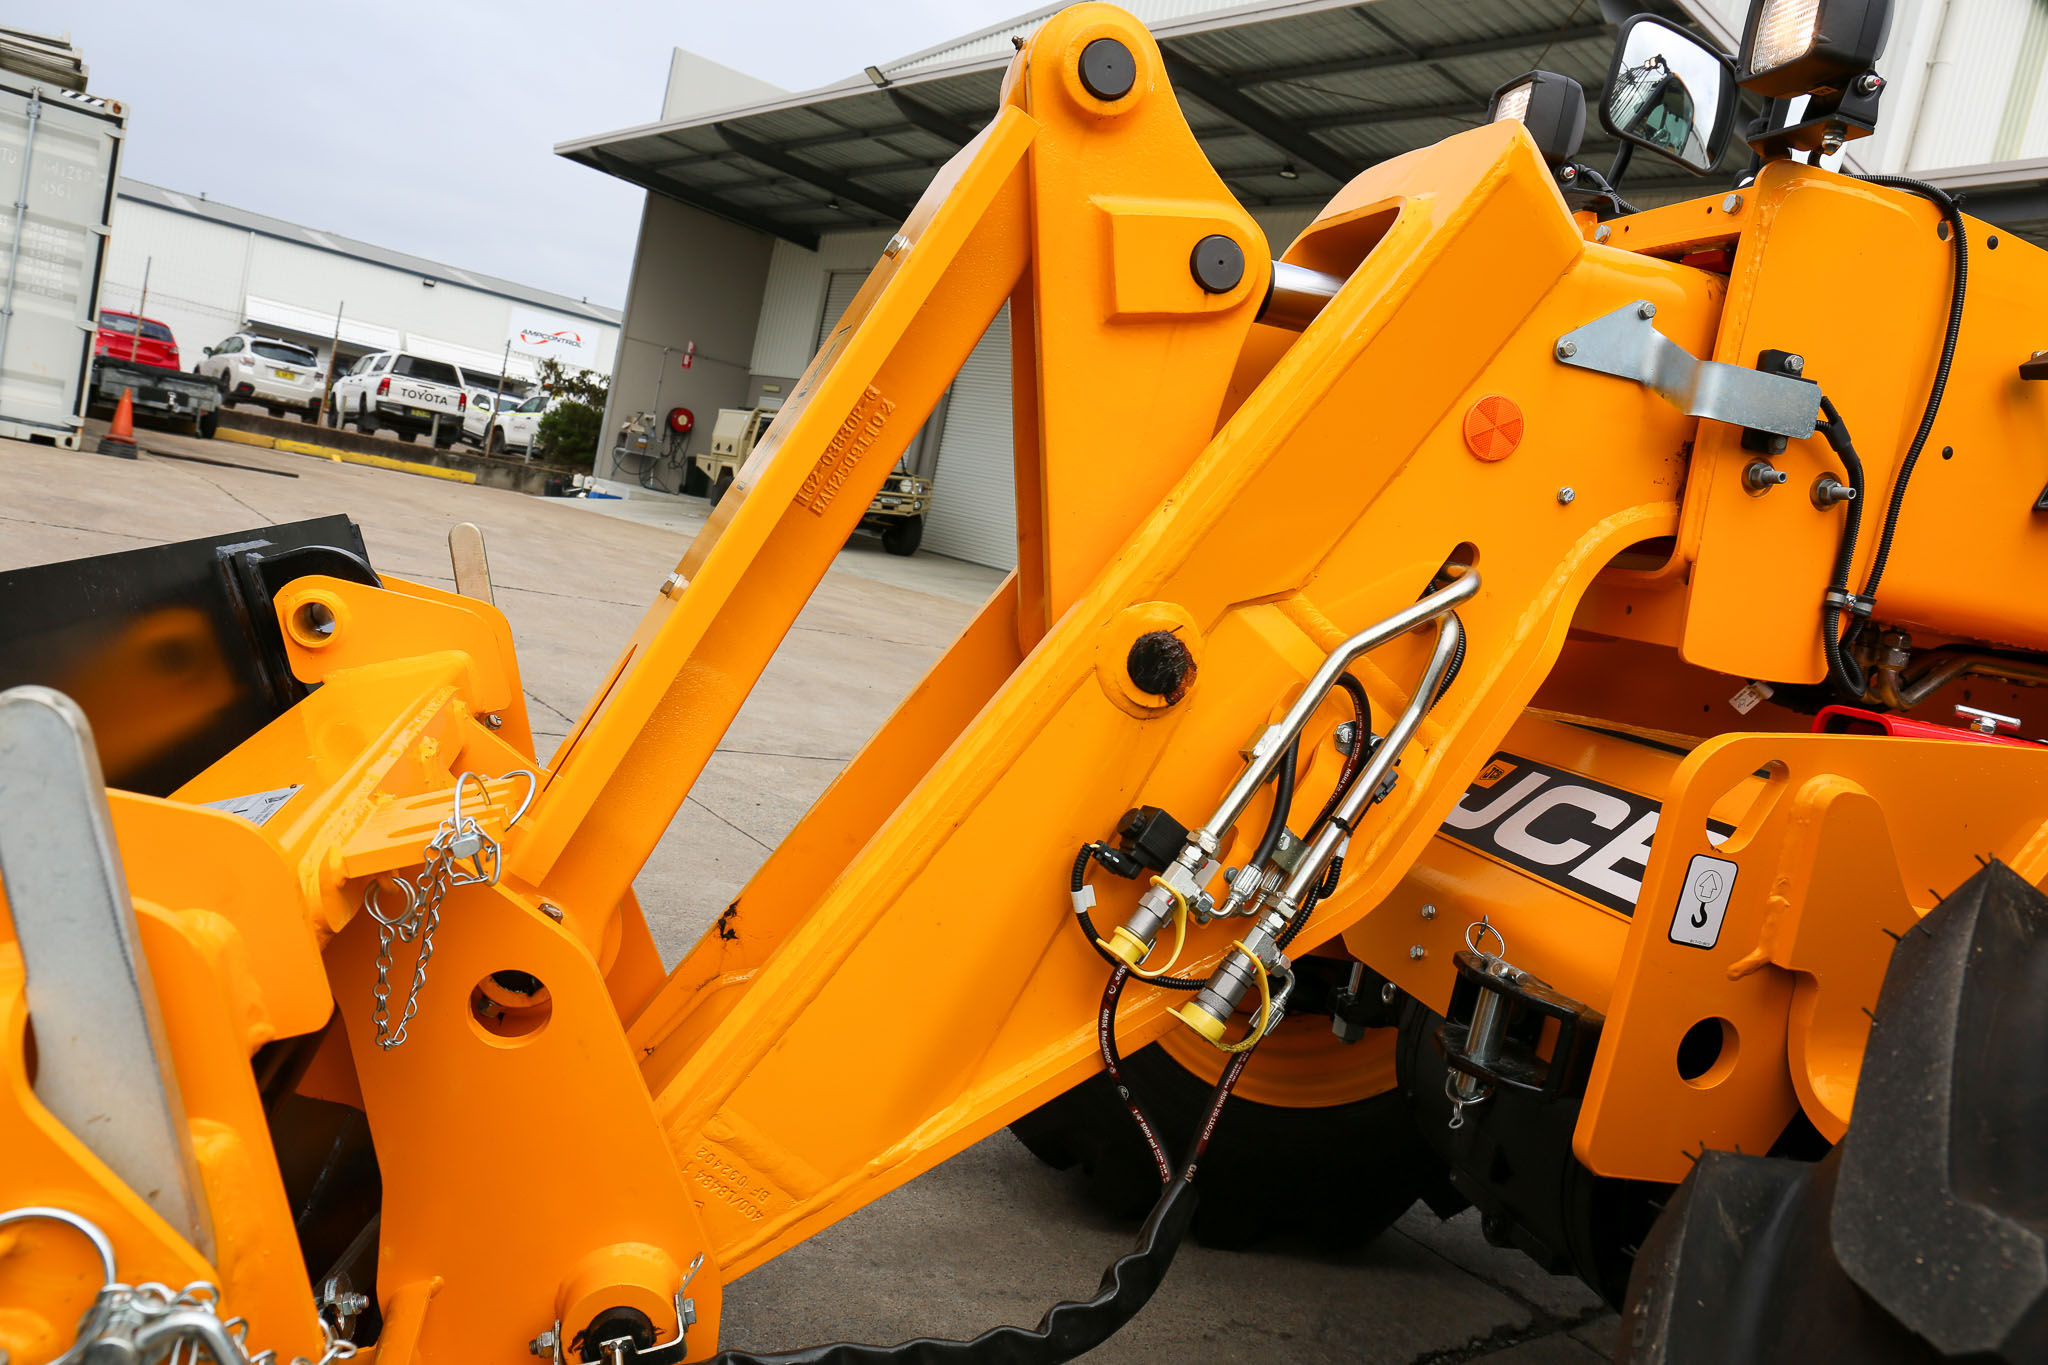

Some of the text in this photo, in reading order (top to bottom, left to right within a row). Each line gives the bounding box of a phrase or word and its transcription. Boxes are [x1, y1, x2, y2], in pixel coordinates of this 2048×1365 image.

[521, 328, 582, 348] AMPCONTROL
[401, 388, 448, 405] TOYOTA
[1216, 1090, 1229, 1108] MSHA
[1140, 1122, 1152, 1138] 5000
